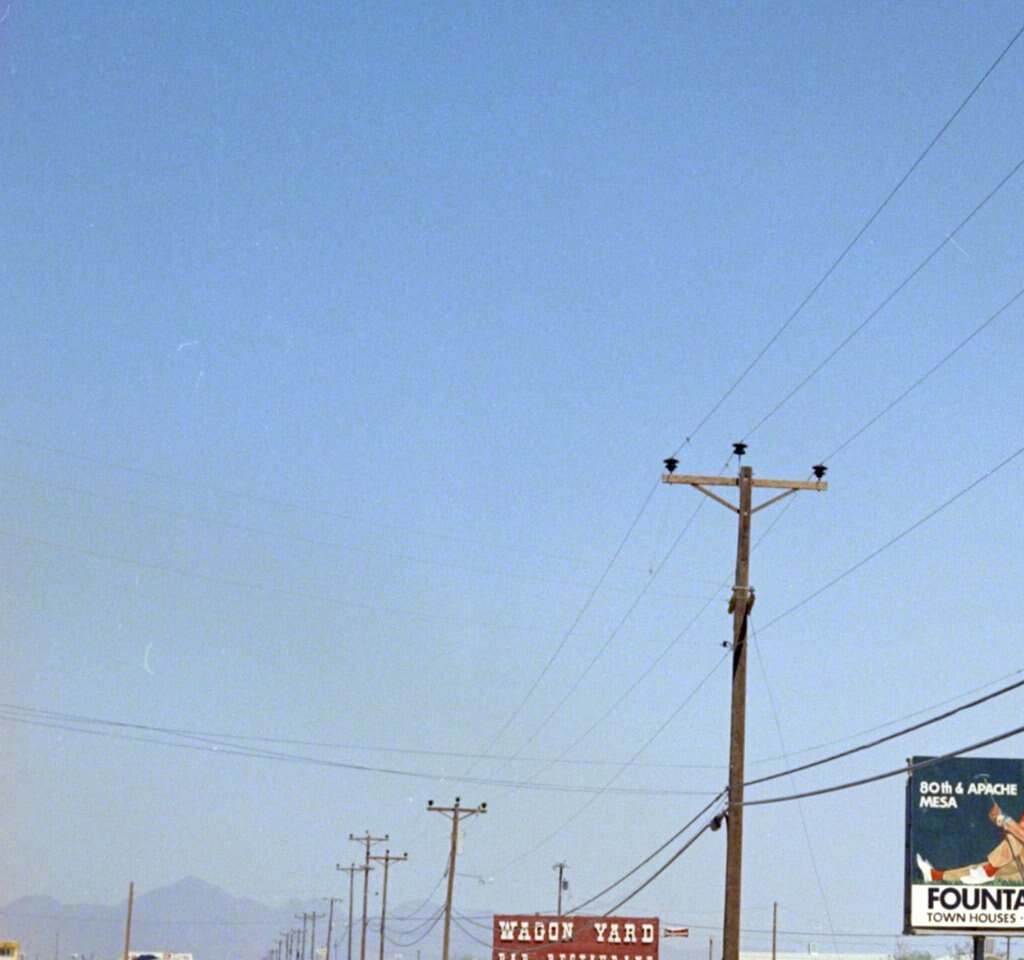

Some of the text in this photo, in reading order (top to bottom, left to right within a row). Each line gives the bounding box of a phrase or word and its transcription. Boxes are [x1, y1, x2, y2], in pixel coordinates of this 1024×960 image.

[920, 781, 1017, 796] 80th & APACHE
[919, 796, 958, 809] MESA
[927, 912, 966, 923] TOWN
[969, 912, 1016, 924] HOUSES
[498, 921, 655, 943] WAGON YARD
